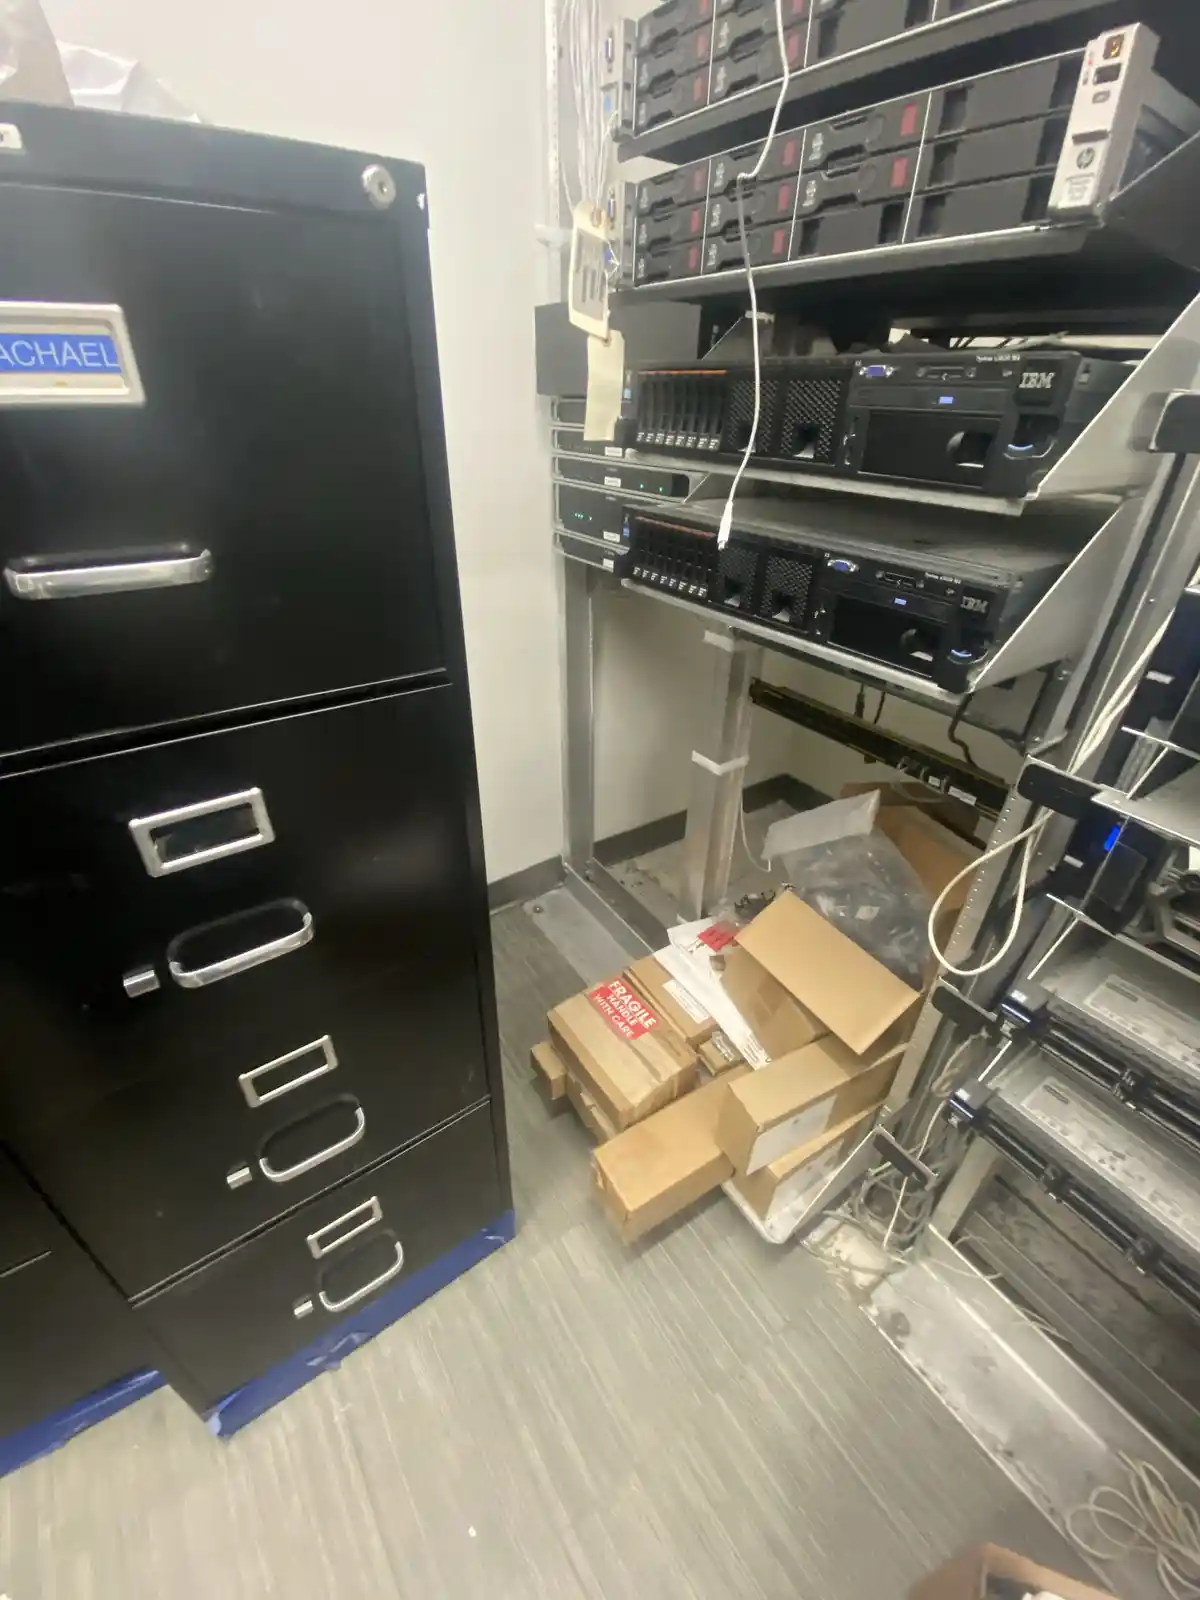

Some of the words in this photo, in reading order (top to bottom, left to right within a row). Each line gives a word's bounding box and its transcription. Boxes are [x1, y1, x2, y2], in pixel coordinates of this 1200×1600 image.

[1019, 372, 1056, 389] IBM
[960, 595, 989, 614] IBM
[595, 993, 615, 1016] WITH
[612, 1015, 635, 1037] CARE
[607, 994, 638, 1027] HANDLE
[608, 980, 657, 1029] FRAGILE
